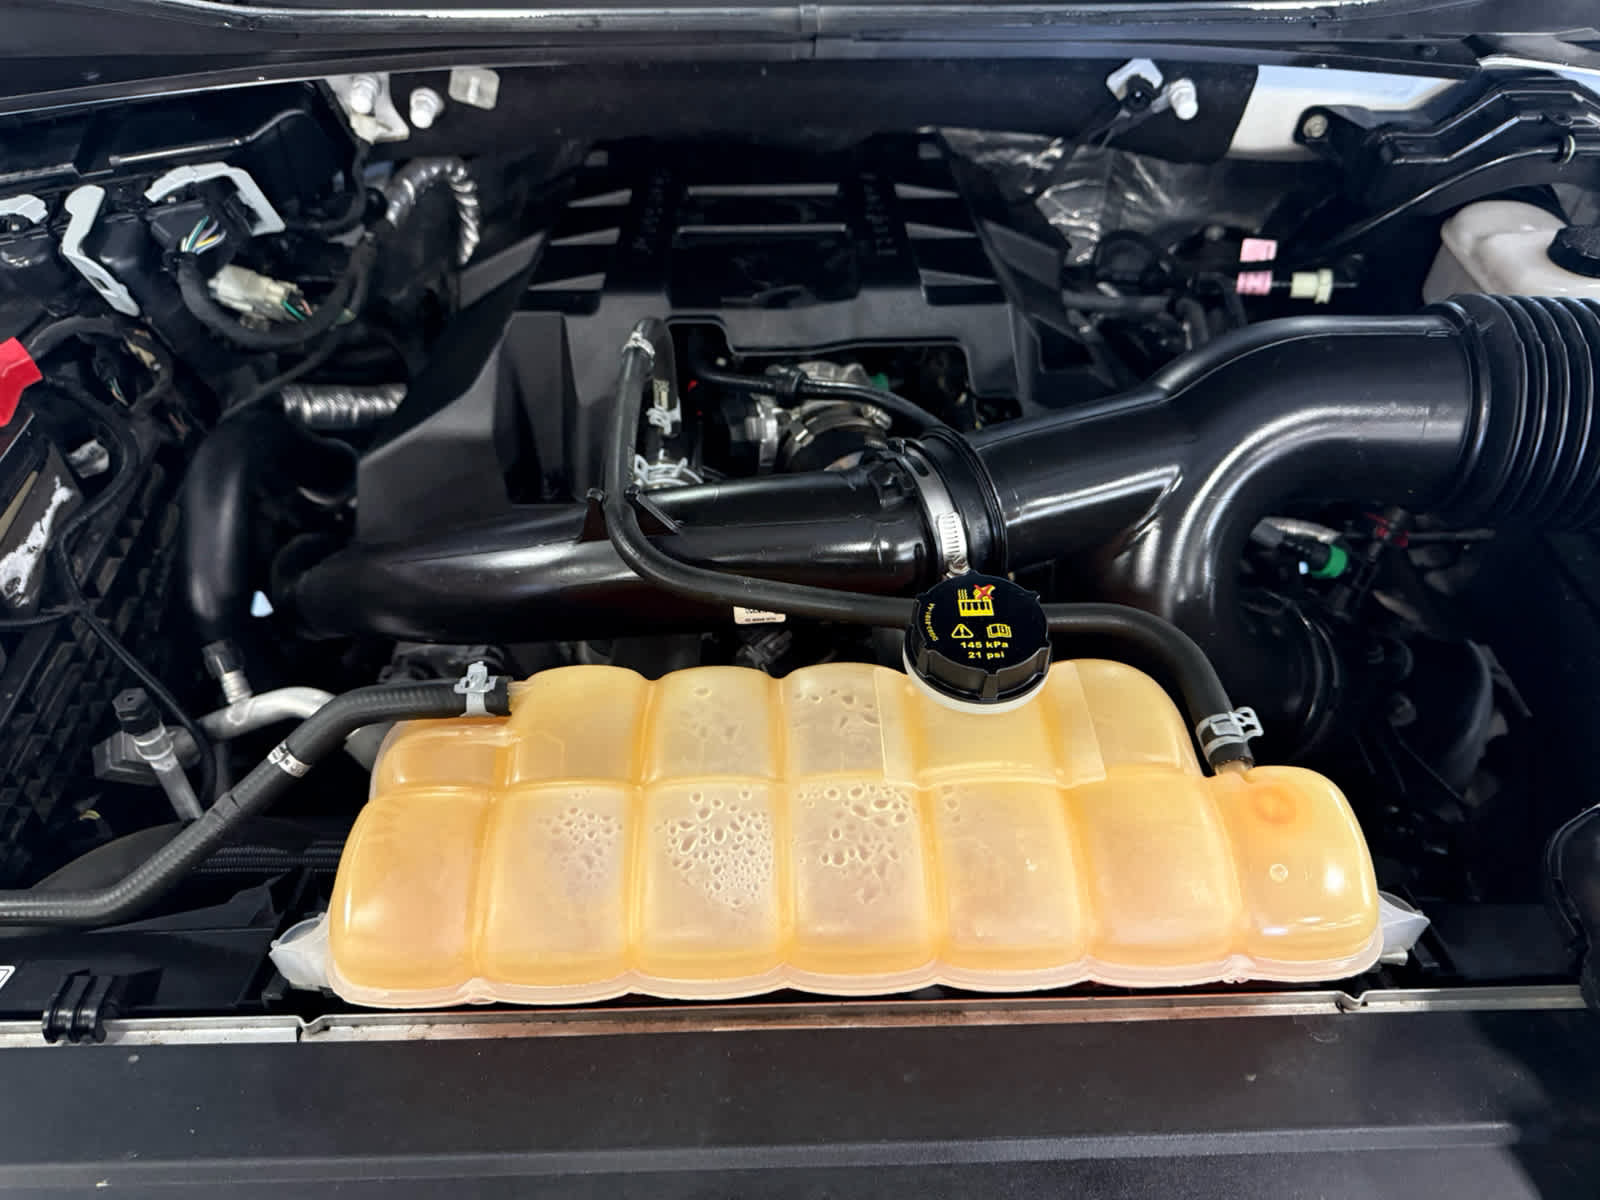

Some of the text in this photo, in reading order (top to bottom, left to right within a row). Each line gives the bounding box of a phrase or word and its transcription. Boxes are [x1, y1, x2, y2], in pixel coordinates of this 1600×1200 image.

[960, 640, 1009, 649] 145 kPa
[967, 650, 1005, 660] 21 psi
